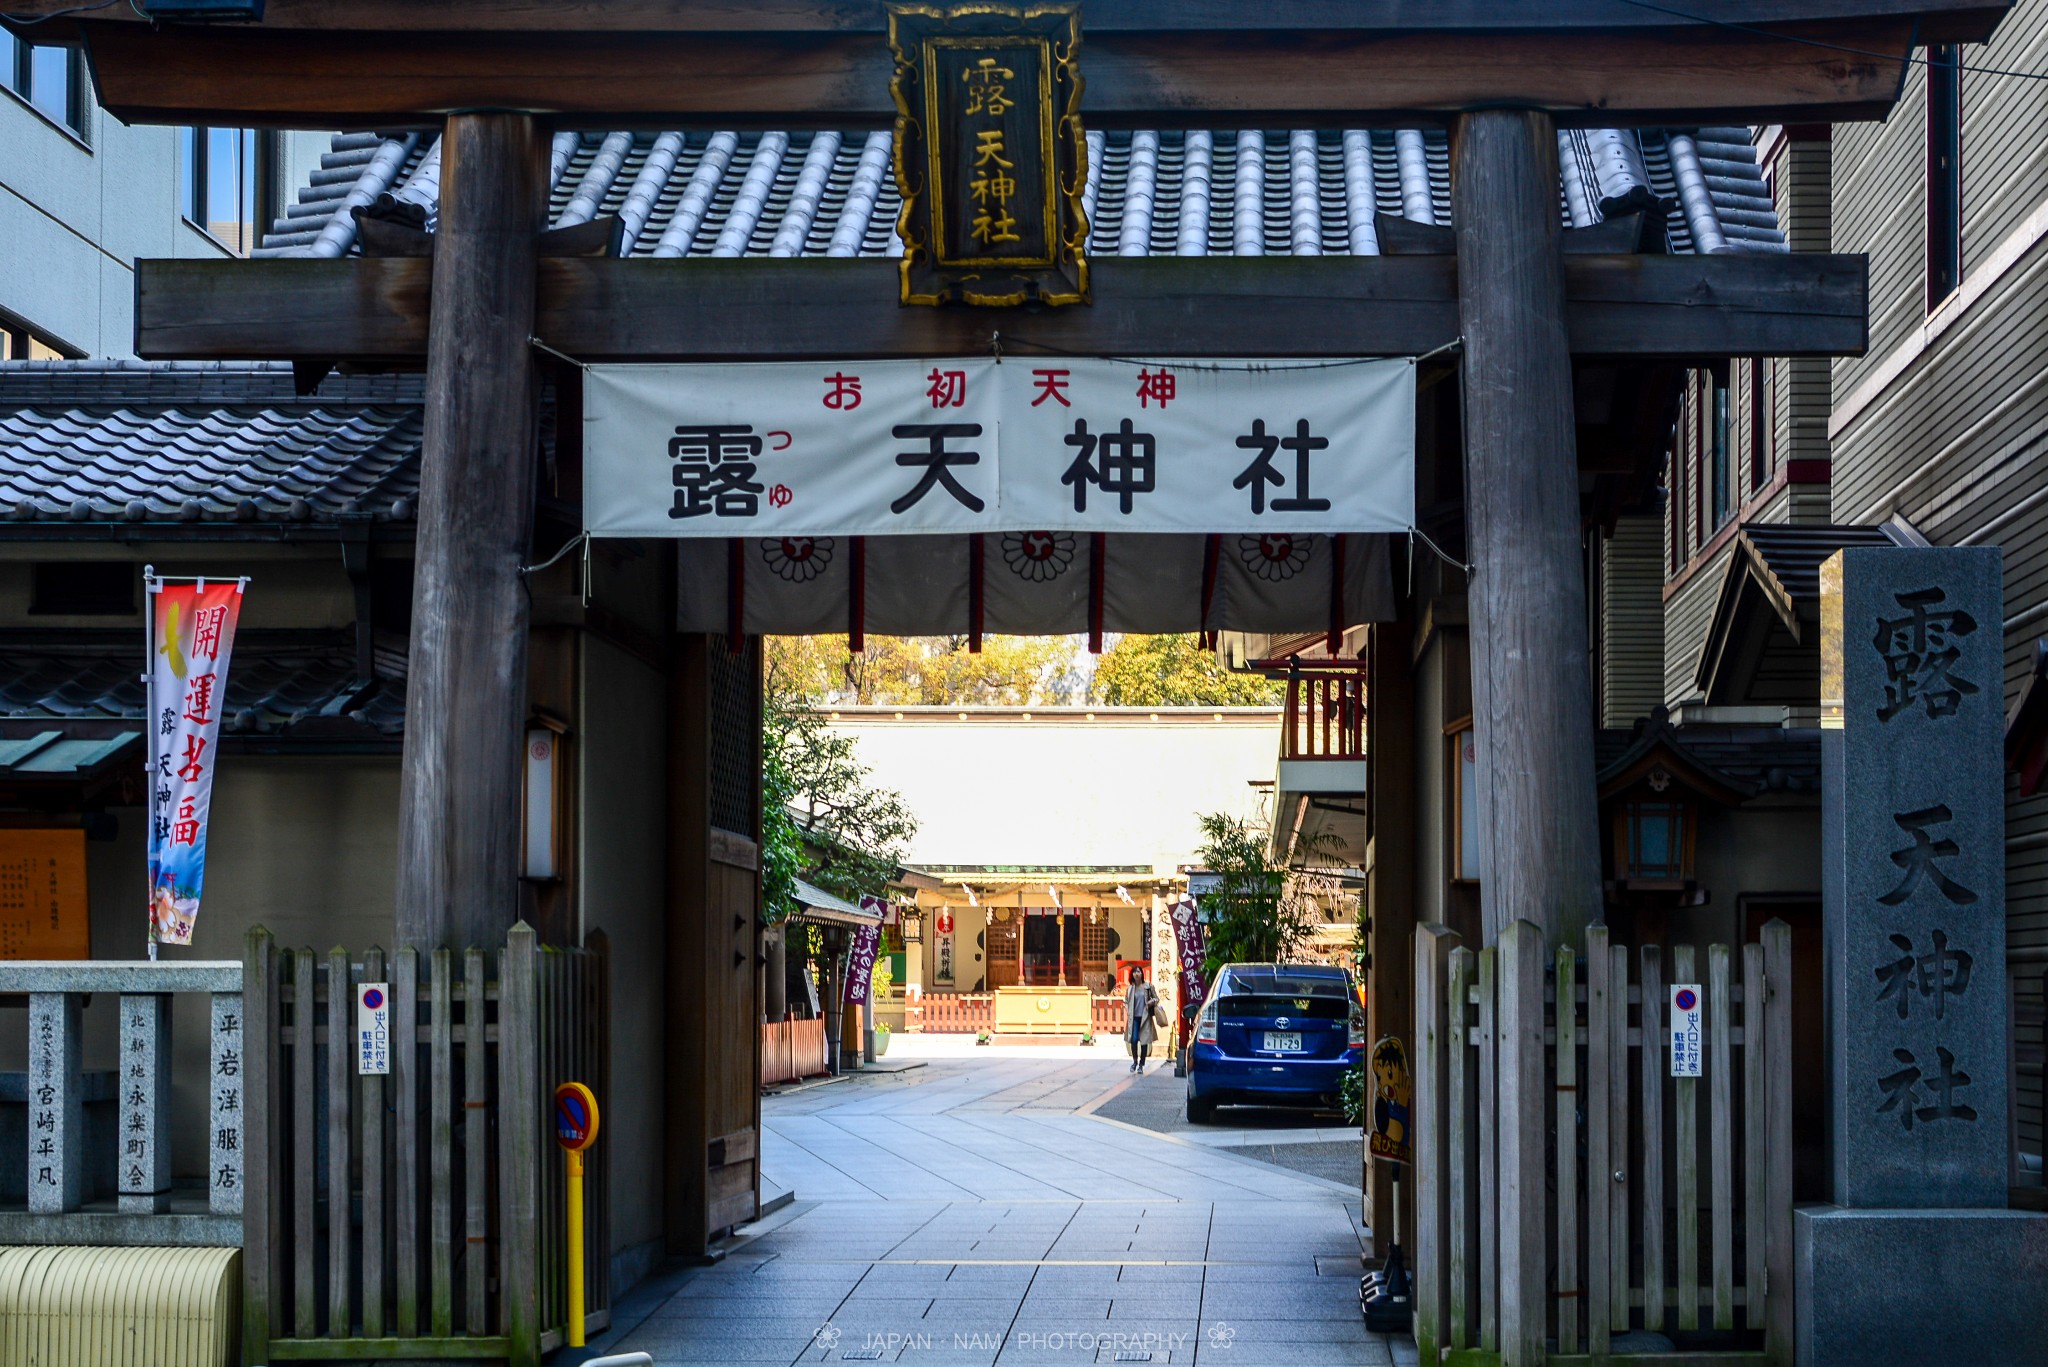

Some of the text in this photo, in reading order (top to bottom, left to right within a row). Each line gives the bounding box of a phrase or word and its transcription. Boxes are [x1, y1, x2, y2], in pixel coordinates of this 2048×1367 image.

[962, 58, 1020, 244] 露天神社
[822, 367, 1177, 410] お初天神
[668, 418, 1332, 517] 露天神社
[154, 707, 177, 843] 露天神社
[1873, 585, 1978, 1131] 露天神社
[1178, 925, 1203, 1000] 恋人の聖地
[362, 1031, 373, 1070] 駐車禁止
[375, 1011, 386, 1070] 出入口に付き
[1273, 1039, 1300, 1050] 11-29
[1674, 1032, 1685, 1072] 駐車禁止
[1687, 1012, 1699, 1072] 出入口に付き
[37, 1083, 57, 1186] 宮崎平凡
[127, 1014, 147, 1188] 北新地永楽町会
[215, 1013, 240, 1189] 平岩洋服店
